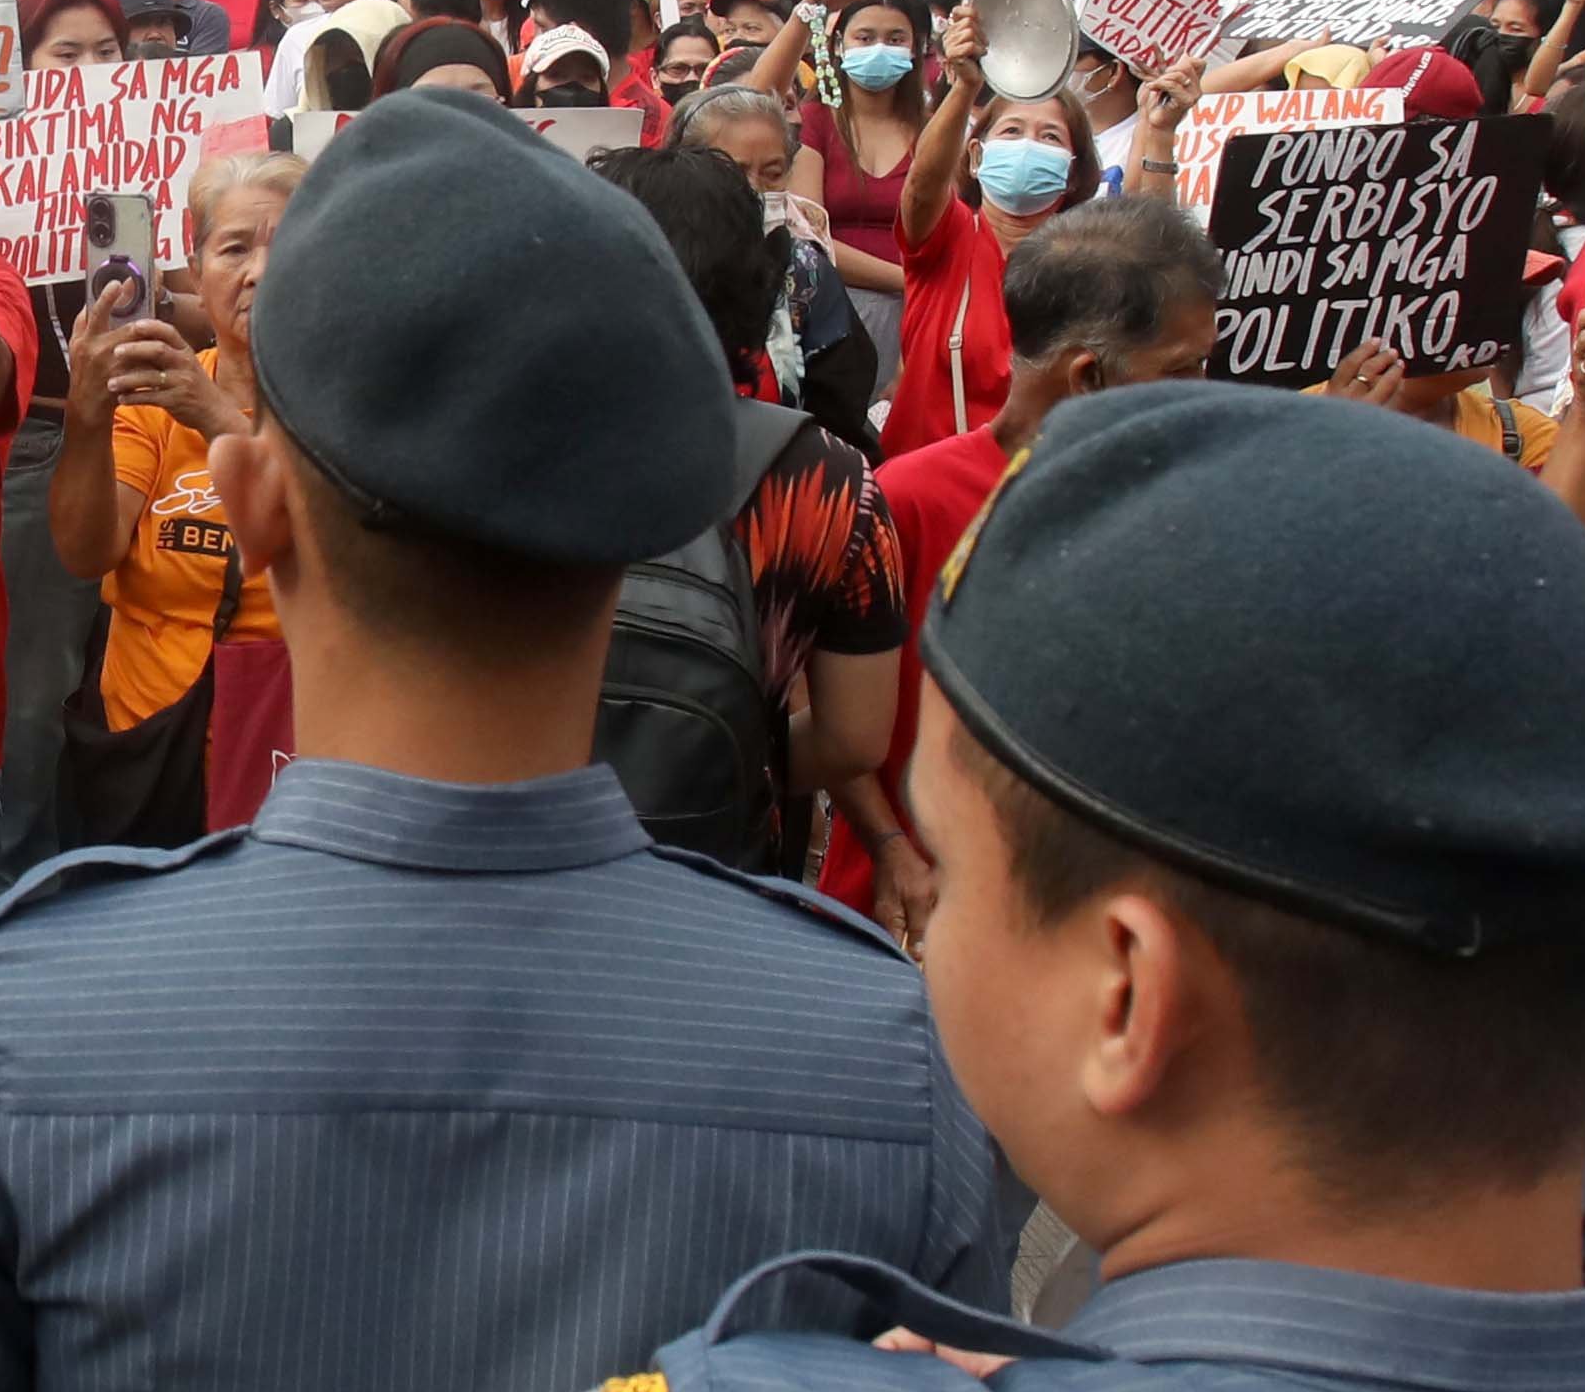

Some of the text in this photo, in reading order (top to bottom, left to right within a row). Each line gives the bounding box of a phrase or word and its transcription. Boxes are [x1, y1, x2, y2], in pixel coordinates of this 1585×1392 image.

[111, 55, 240, 106] SA MGA
[1257, 88, 1385, 123] WALANG
[152, 97, 202, 135] NG
[1251, 121, 1479, 188] PONDO SA
[1242, 176, 1498, 255] SERBISYO
[1321, 242, 1369, 289] SA
[1369, 234, 1468, 297] MGA
